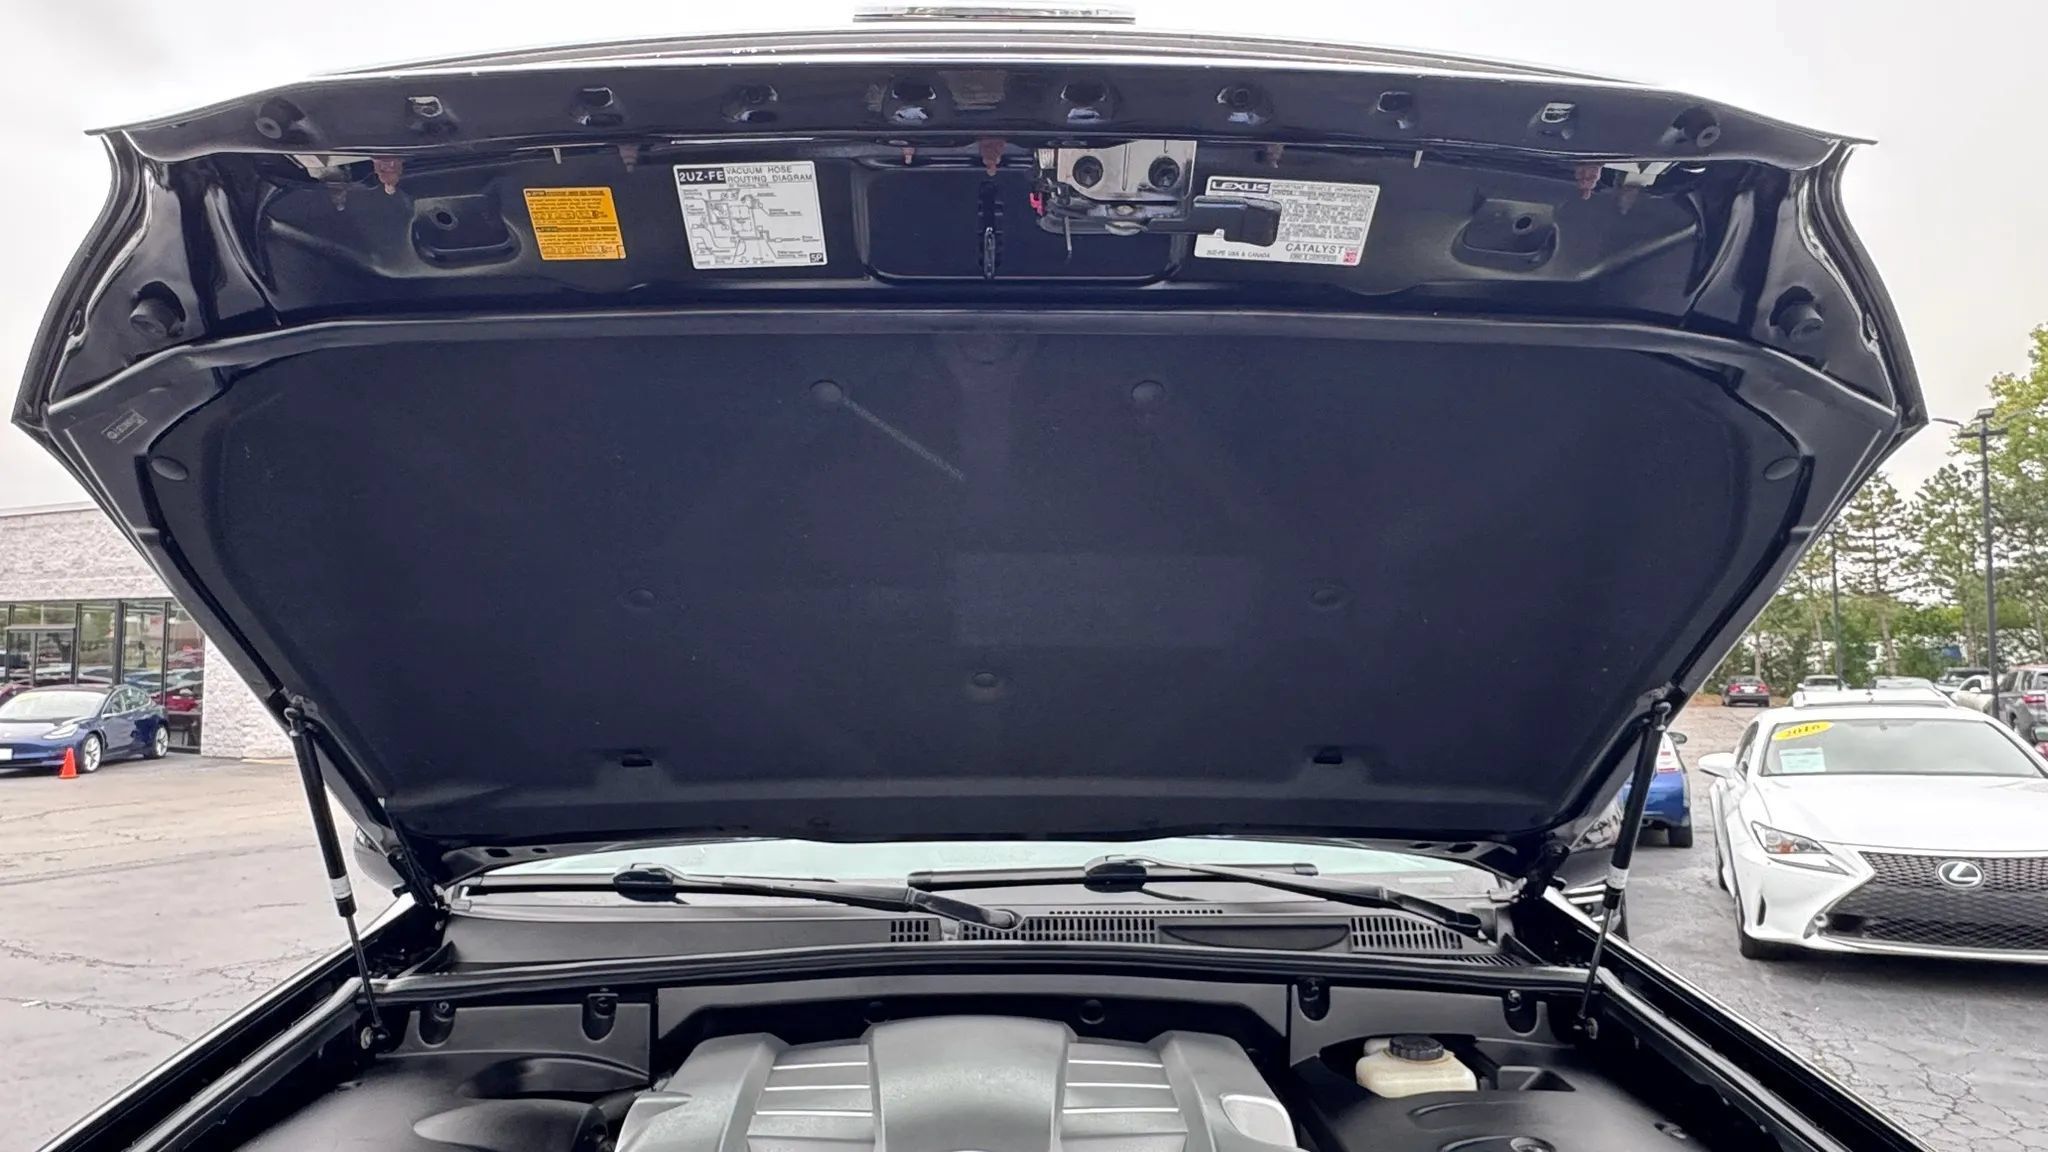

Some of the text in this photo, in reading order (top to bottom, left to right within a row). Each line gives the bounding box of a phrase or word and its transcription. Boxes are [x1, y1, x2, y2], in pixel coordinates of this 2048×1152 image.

[726, 165, 793, 175] VACUUM HOSE
[679, 171, 725, 182] 2UZ-FE
[727, 174, 813, 183] ROUTING DIAGRAM
[1212, 181, 1270, 192] LEXUS
[1285, 242, 1344, 255] CATALYST
